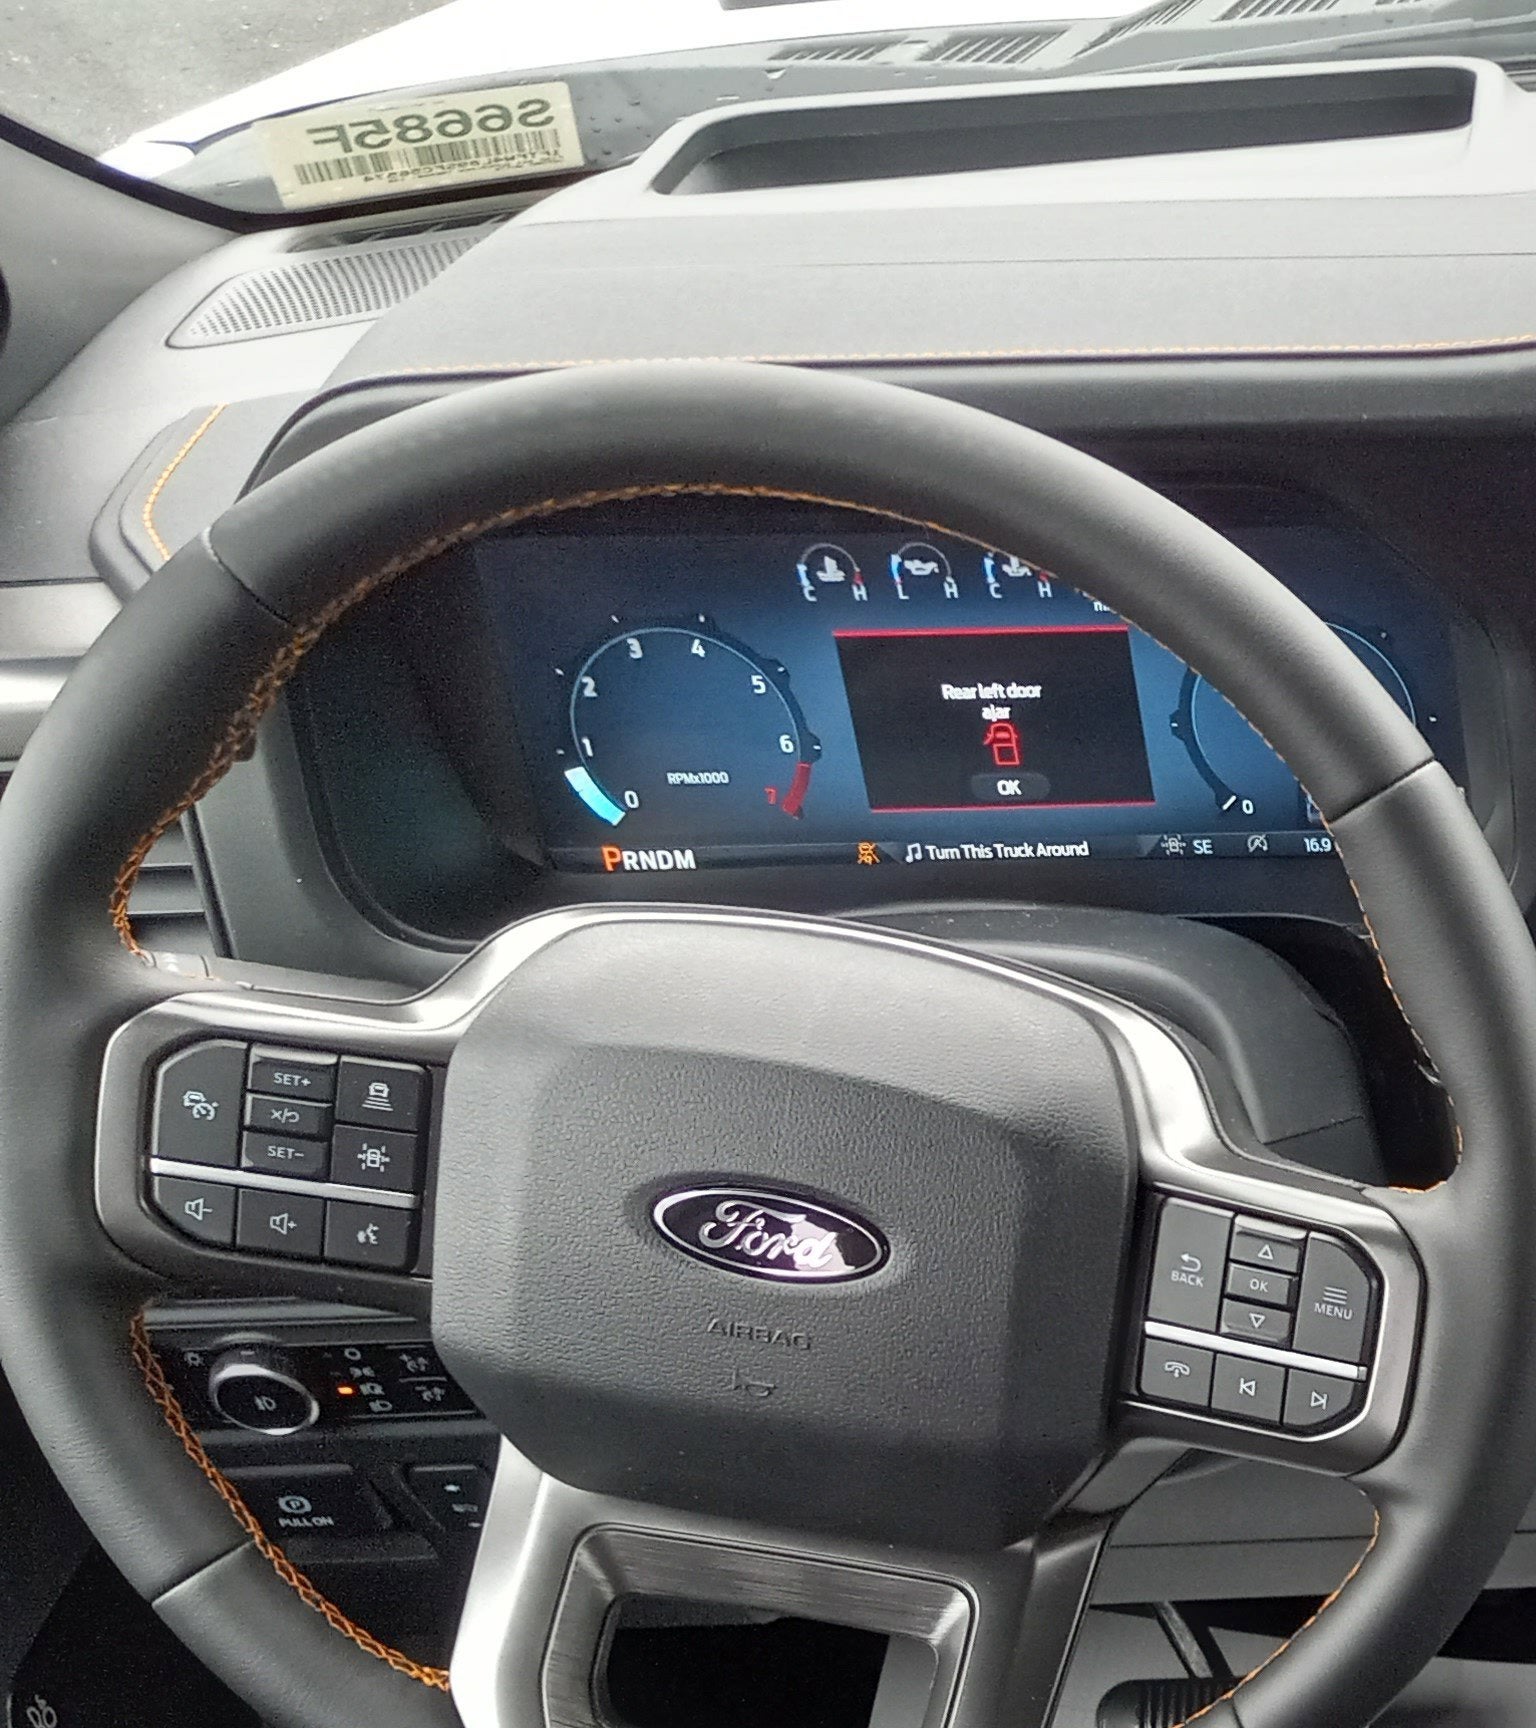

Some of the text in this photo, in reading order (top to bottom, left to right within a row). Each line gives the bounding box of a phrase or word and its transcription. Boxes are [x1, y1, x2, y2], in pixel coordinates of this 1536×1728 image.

[852, 584, 868, 601] H
[943, 581, 959, 599] H
[627, 638, 643, 659] 3
[690, 638, 706, 658] 4
[581, 676, 598, 698] 2
[750, 675, 767, 695] 5
[941, 681, 1042, 700] Rear left door
[981, 704, 1011, 722] ajar
[581, 737, 594, 757] 1
[778, 734, 795, 754] 6
[666, 771, 729, 786] RPMx1000
[996, 780, 1022, 796] OK
[624, 790, 640, 810] 0
[1241, 799, 1255, 815] 0
[925, 840, 1090, 861] Turn This Truck Around
[1192, 839, 1215, 855] SE
[699, 1199, 839, 1270] Ford
[1170, 1269, 1205, 1288] BACK
[1249, 1277, 1270, 1292] OK
[1313, 1301, 1353, 1321] MENU
[706, 1317, 813, 1351] AIRBAG
[312, 1515, 335, 1527] ON
